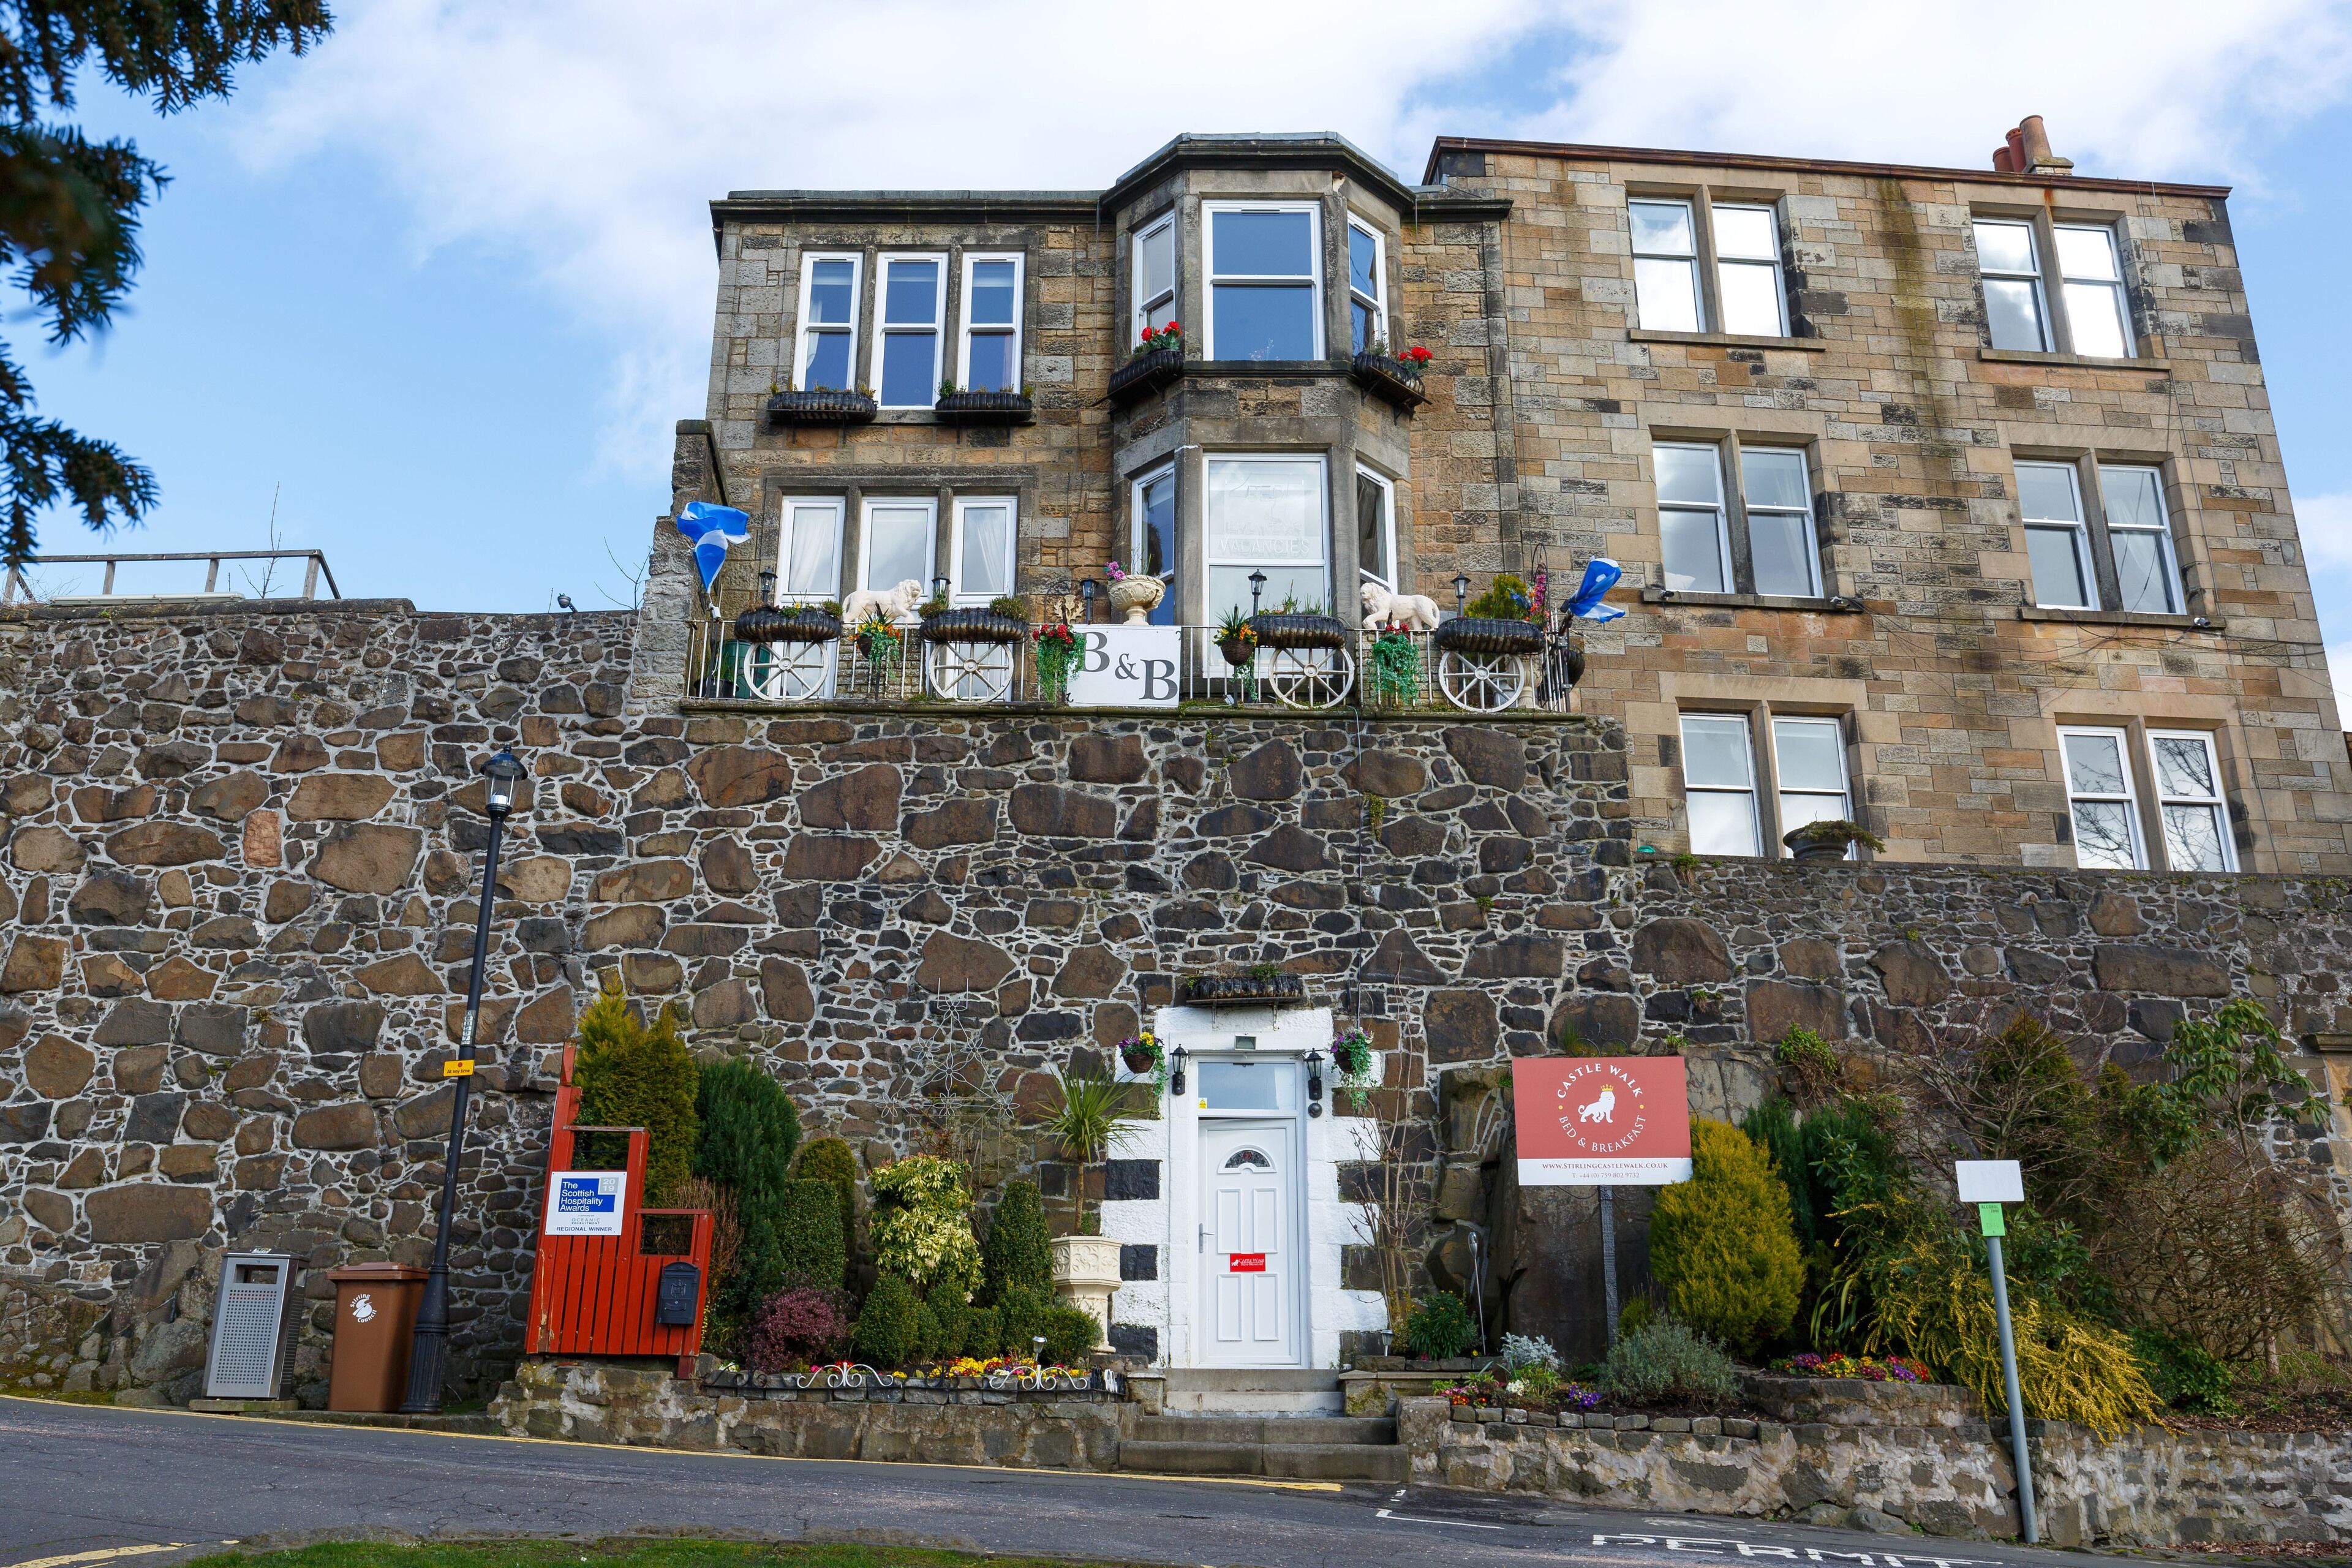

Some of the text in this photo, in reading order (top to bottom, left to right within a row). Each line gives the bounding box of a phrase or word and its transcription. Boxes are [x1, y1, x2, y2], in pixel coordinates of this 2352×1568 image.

[1220, 538, 1310, 554] VACANCIES
[1557, 1063, 1643, 1098] CASTLE WALK
[1559, 1115, 1646, 1152] BED & BREAKFAST
[560, 1197, 603, 1206] Hospitality
[350, 1294, 371, 1308] Stirling
[358, 1310, 377, 1323] Council
[1592, 1534, 1973, 1568] PERMIT
